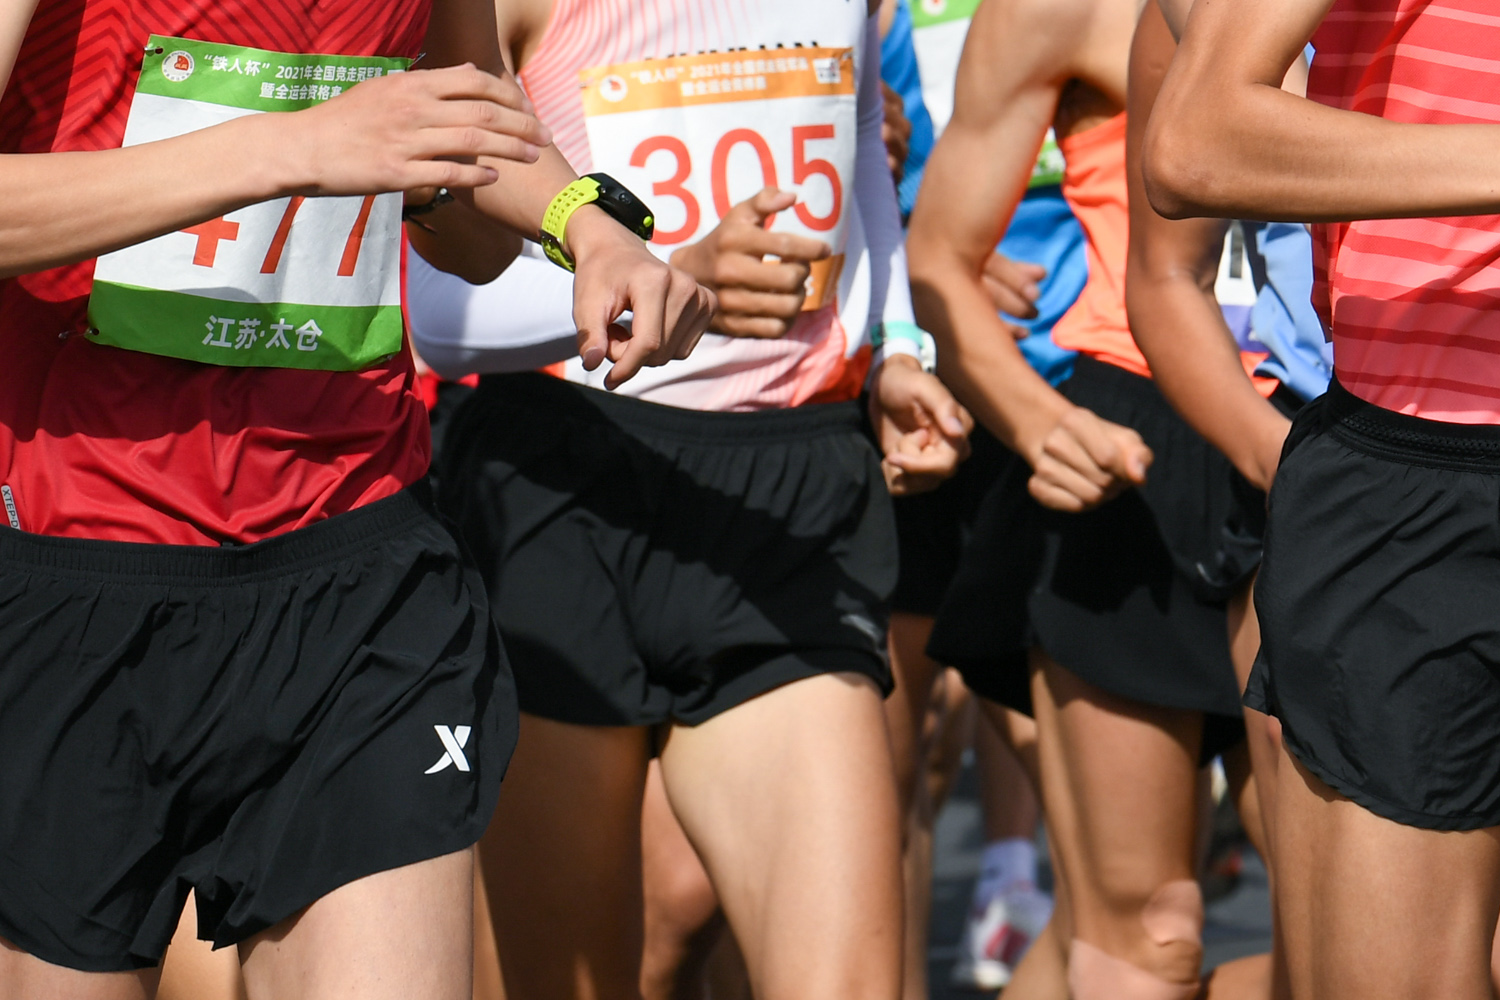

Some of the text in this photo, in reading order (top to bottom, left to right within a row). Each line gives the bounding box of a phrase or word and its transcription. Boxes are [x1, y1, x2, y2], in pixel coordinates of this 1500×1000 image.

[203, 54, 270, 77] “铁人杯”
[629, 124, 842, 245] 305
[201, 314, 323, 351] 江苏·太仓
